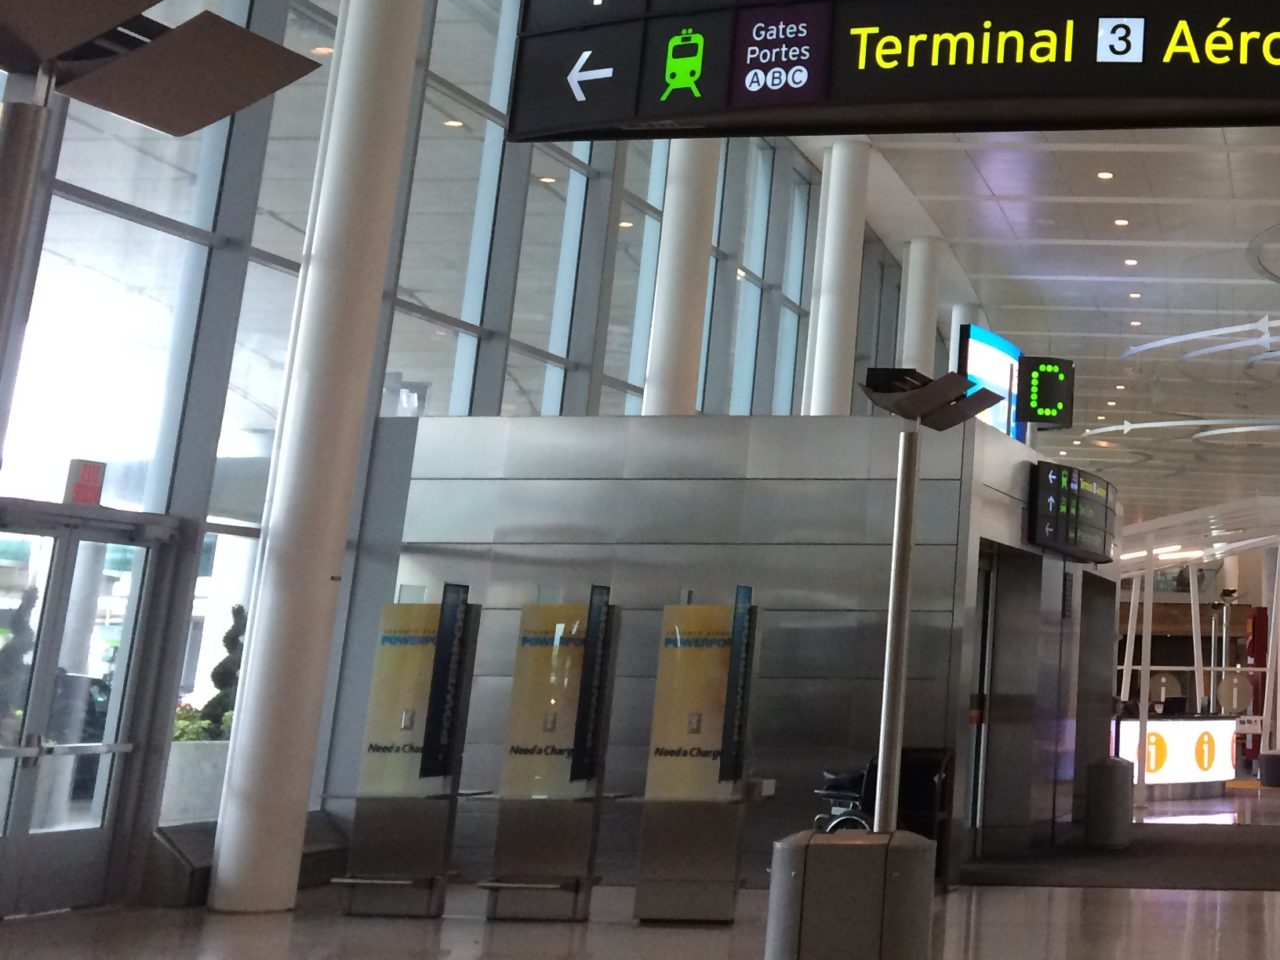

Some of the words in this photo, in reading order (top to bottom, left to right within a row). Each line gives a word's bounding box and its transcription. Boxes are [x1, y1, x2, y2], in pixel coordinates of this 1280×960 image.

[752, 21, 807, 41] Gates
[746, 43, 810, 64] Portes
[850, 20, 1073, 70] Terminal
[1109, 23, 1132, 56] 3
[1030, 365, 1064, 417] C
[367, 743, 393, 753] Need
[509, 745, 535, 755] Need
[654, 747, 682, 757] Need
